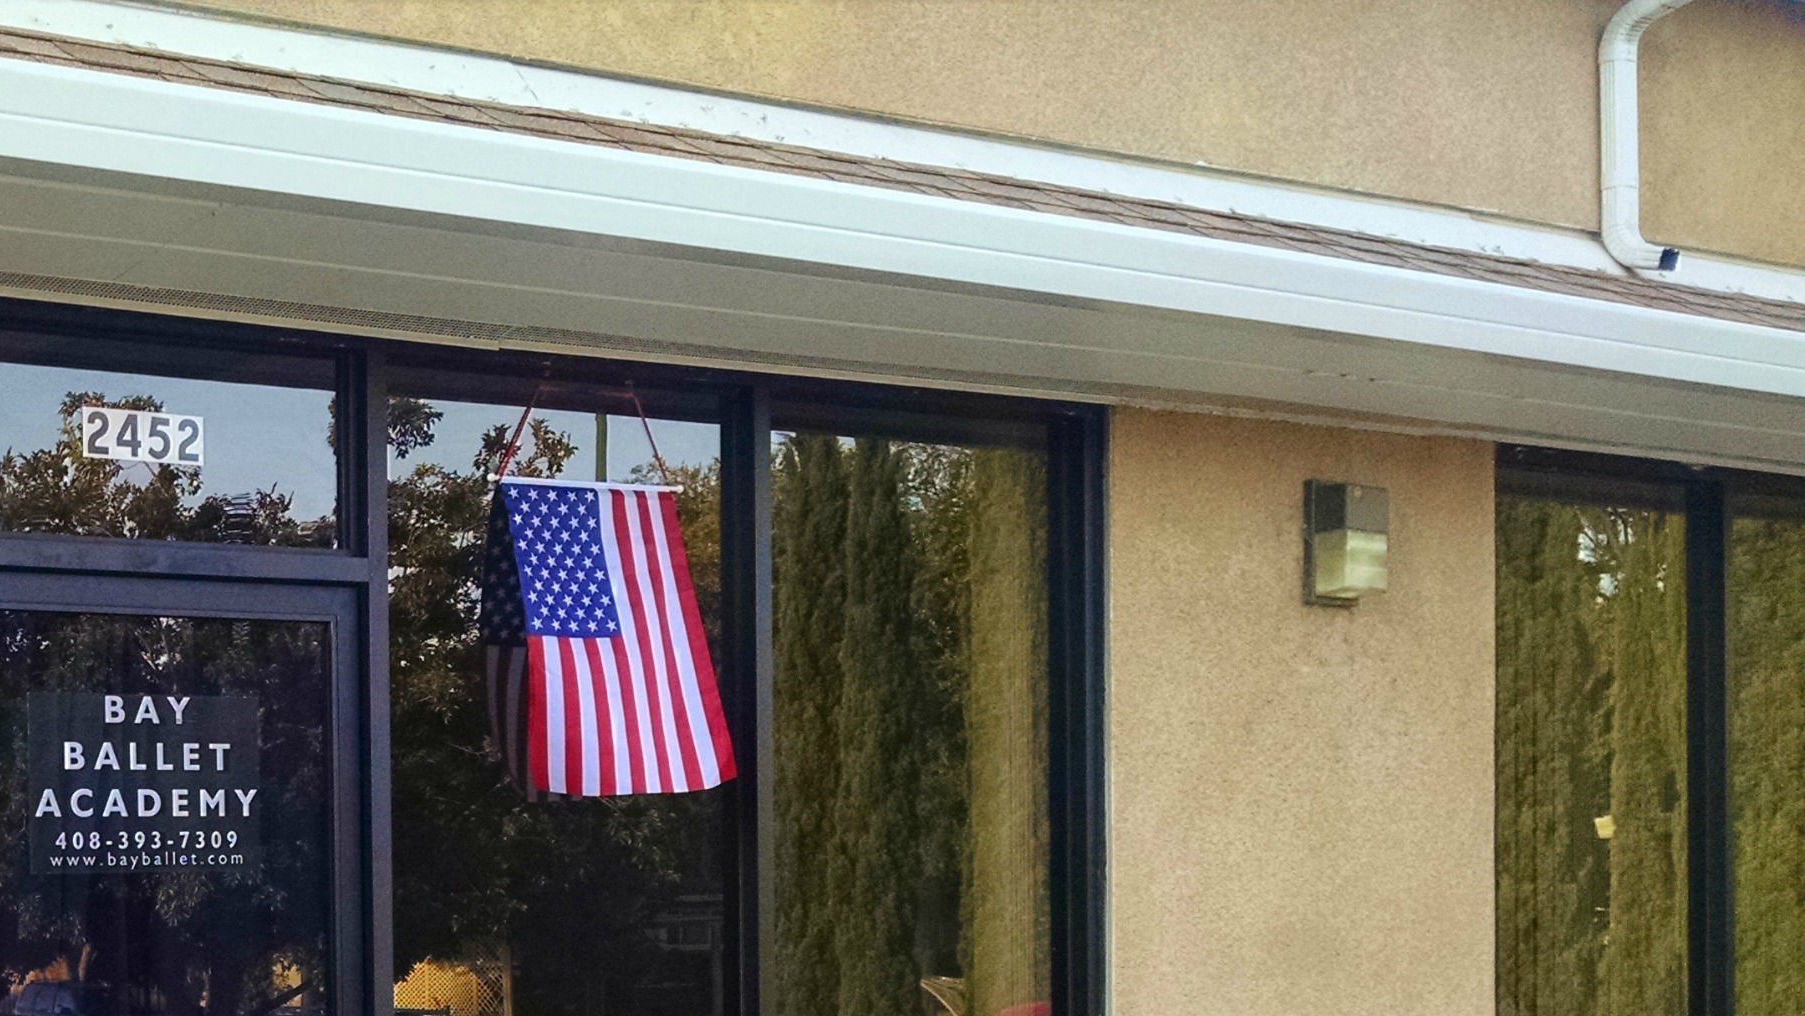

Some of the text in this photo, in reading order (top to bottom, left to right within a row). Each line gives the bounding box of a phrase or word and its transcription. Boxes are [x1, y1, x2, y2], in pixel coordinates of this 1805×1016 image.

[87, 411, 199, 462] 2452
[104, 695, 191, 725] BAY
[63, 741, 231, 771] BALLET
[35, 788, 258, 818] ACADEMY
[55, 831, 239, 850] 408-393-7309
[50, 852, 244, 871] www.bayballet.com
